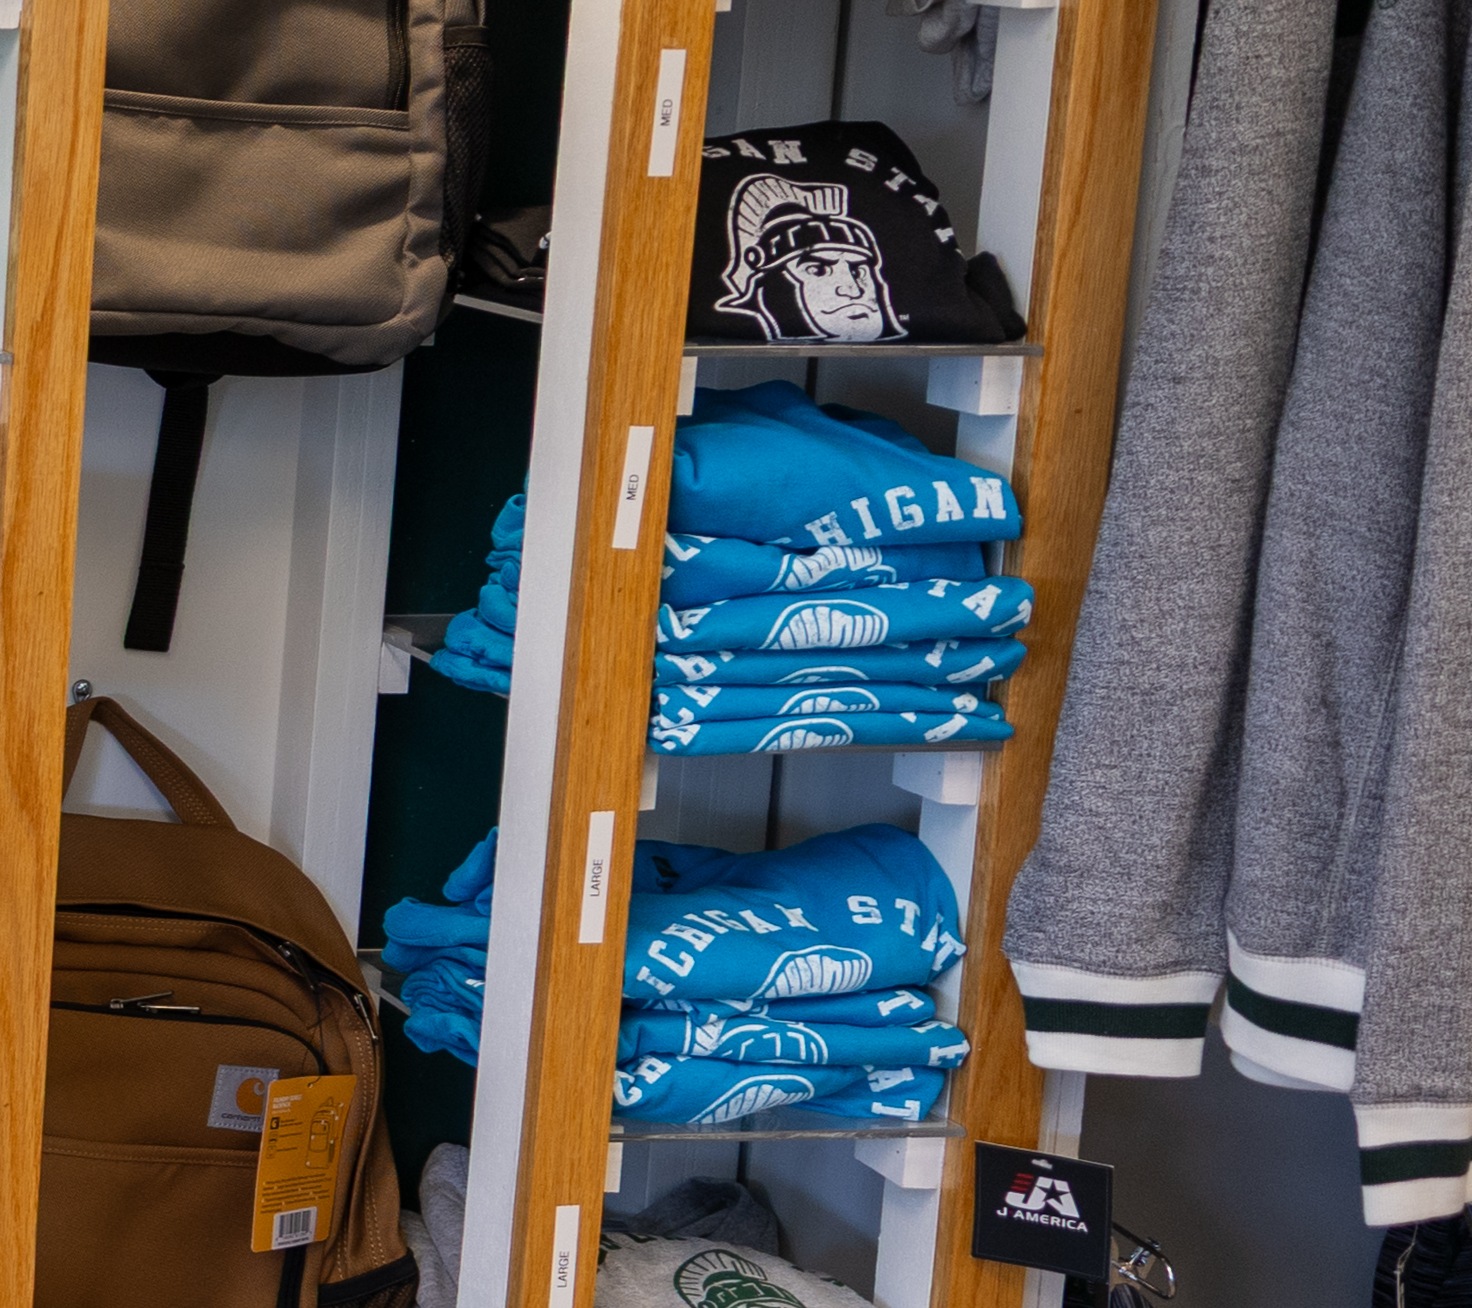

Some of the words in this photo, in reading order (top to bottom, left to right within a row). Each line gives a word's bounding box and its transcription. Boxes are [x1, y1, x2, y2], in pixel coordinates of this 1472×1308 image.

[660, 99, 673, 127] MED
[625, 474, 639, 501] MED
[589, 860, 603, 897] LARGE
[996, 1206, 1008, 1218] J
[1012, 1207, 1089, 1233] AMERICA
[556, 1251, 570, 1288] LARGE
